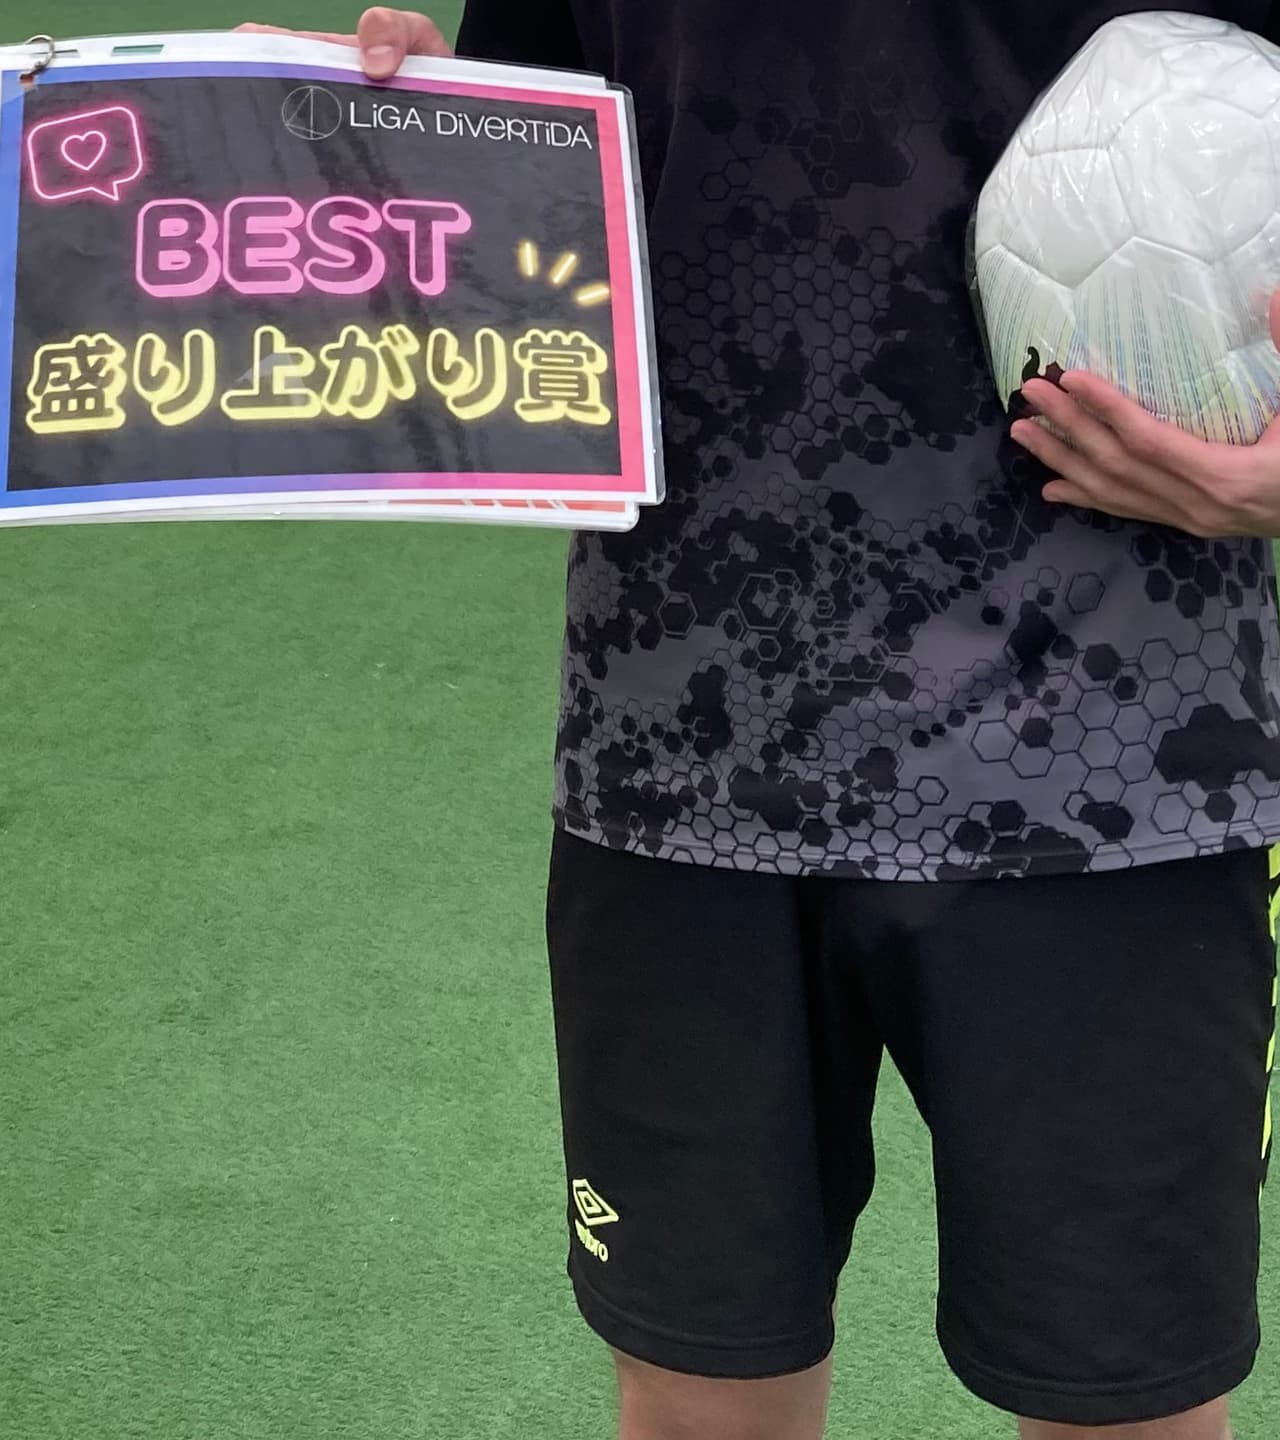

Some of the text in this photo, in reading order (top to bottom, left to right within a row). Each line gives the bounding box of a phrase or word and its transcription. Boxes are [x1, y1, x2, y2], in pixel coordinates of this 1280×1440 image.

[350, 101, 425, 133] LiGA
[136, 195, 471, 297] BEST
[25, 325, 611, 434] 盛り上がり賞
